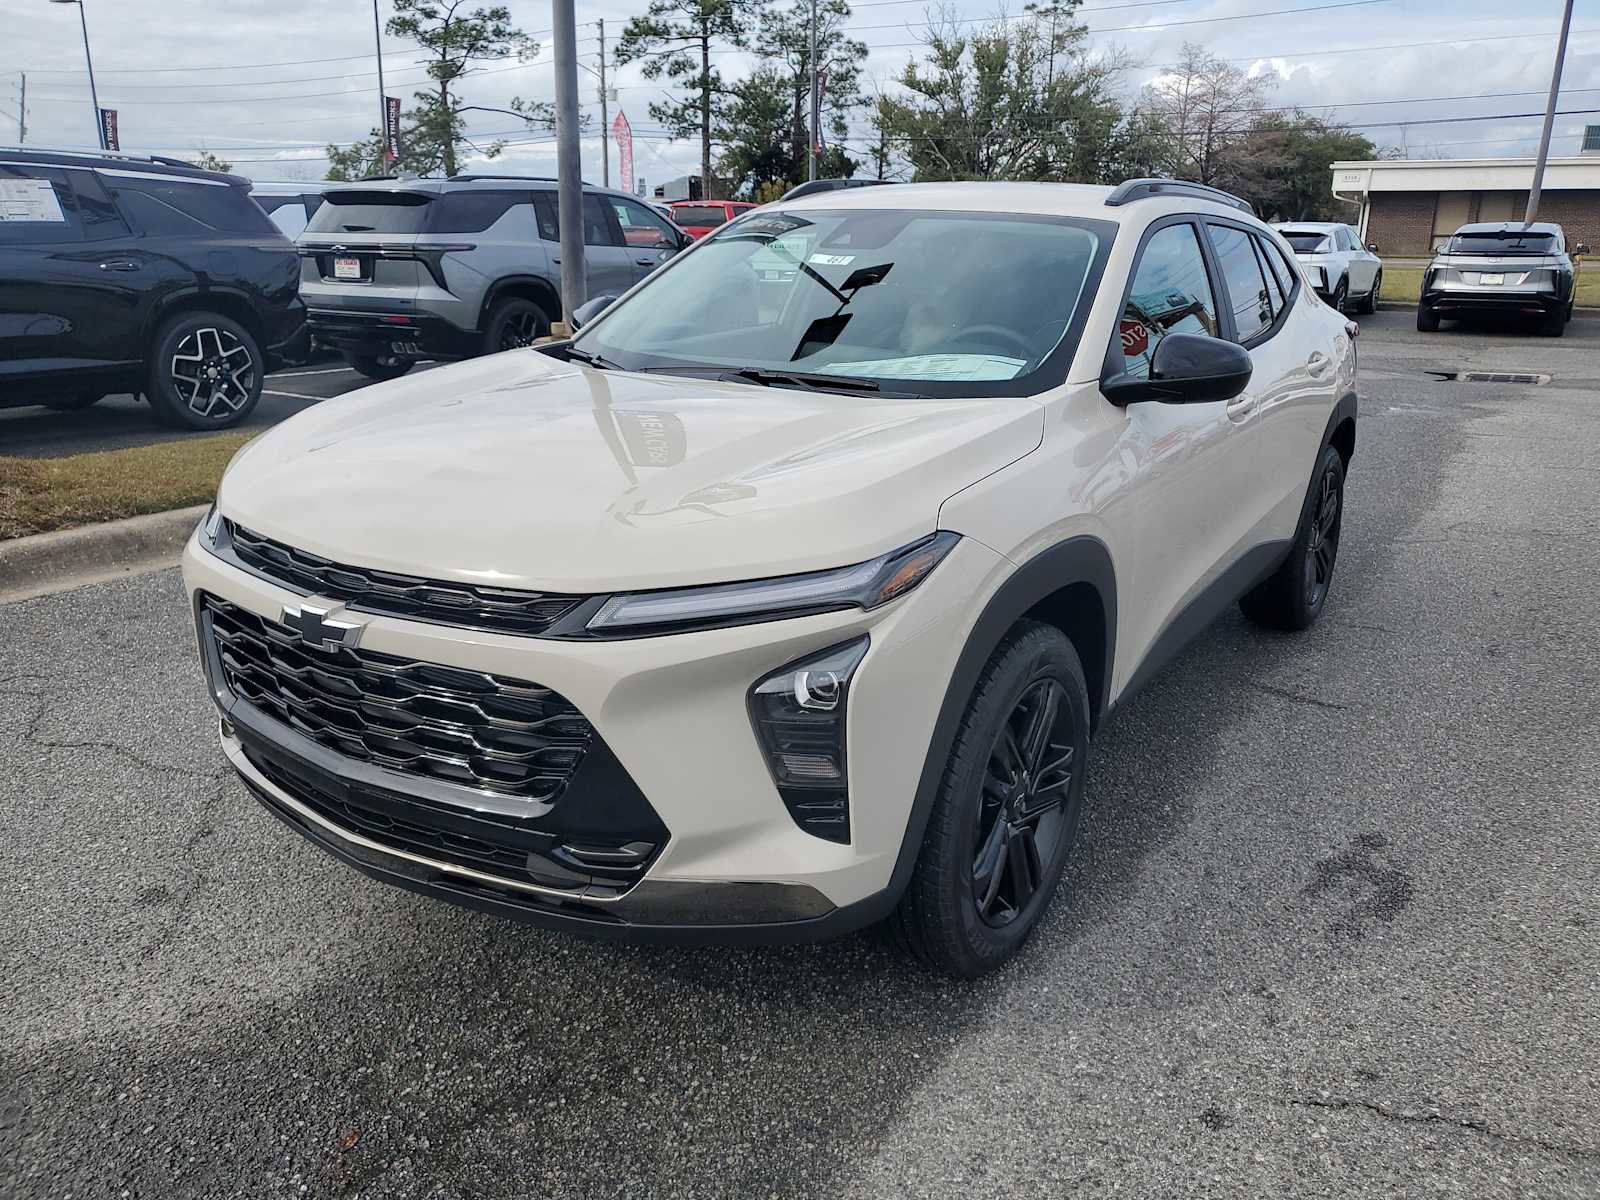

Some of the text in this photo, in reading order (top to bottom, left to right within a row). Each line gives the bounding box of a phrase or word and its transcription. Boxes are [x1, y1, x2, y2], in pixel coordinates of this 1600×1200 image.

[105, 111, 114, 142] TRUCKS
[389, 101, 399, 157] NEW TRUCKS
